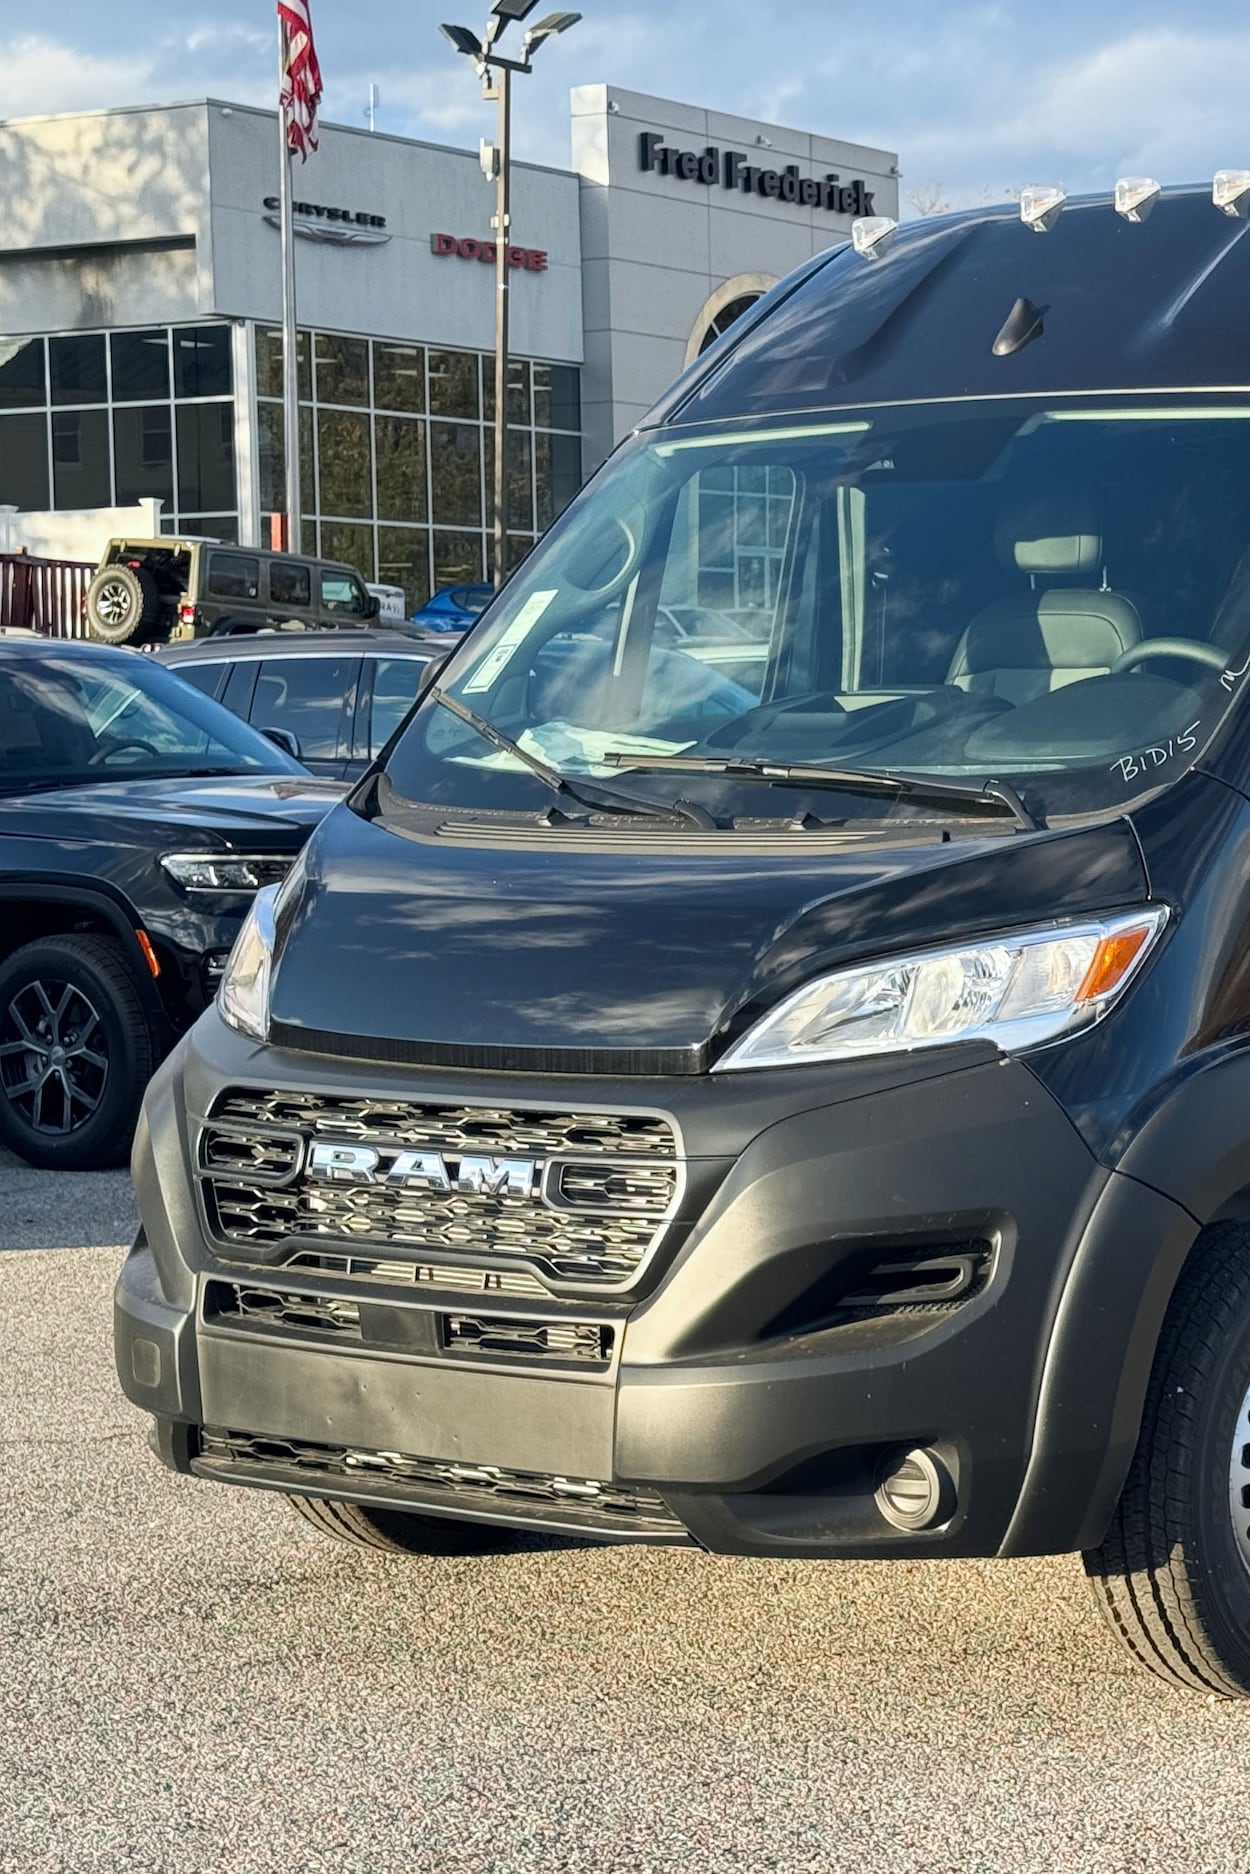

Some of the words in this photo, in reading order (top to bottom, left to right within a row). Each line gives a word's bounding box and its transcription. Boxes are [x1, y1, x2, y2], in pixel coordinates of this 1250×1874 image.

[639, 131, 720, 185] Fred
[724, 151, 876, 217] Frederick
[430, 232, 549, 272] DODGE
[311, 1141, 535, 1198] RAM
